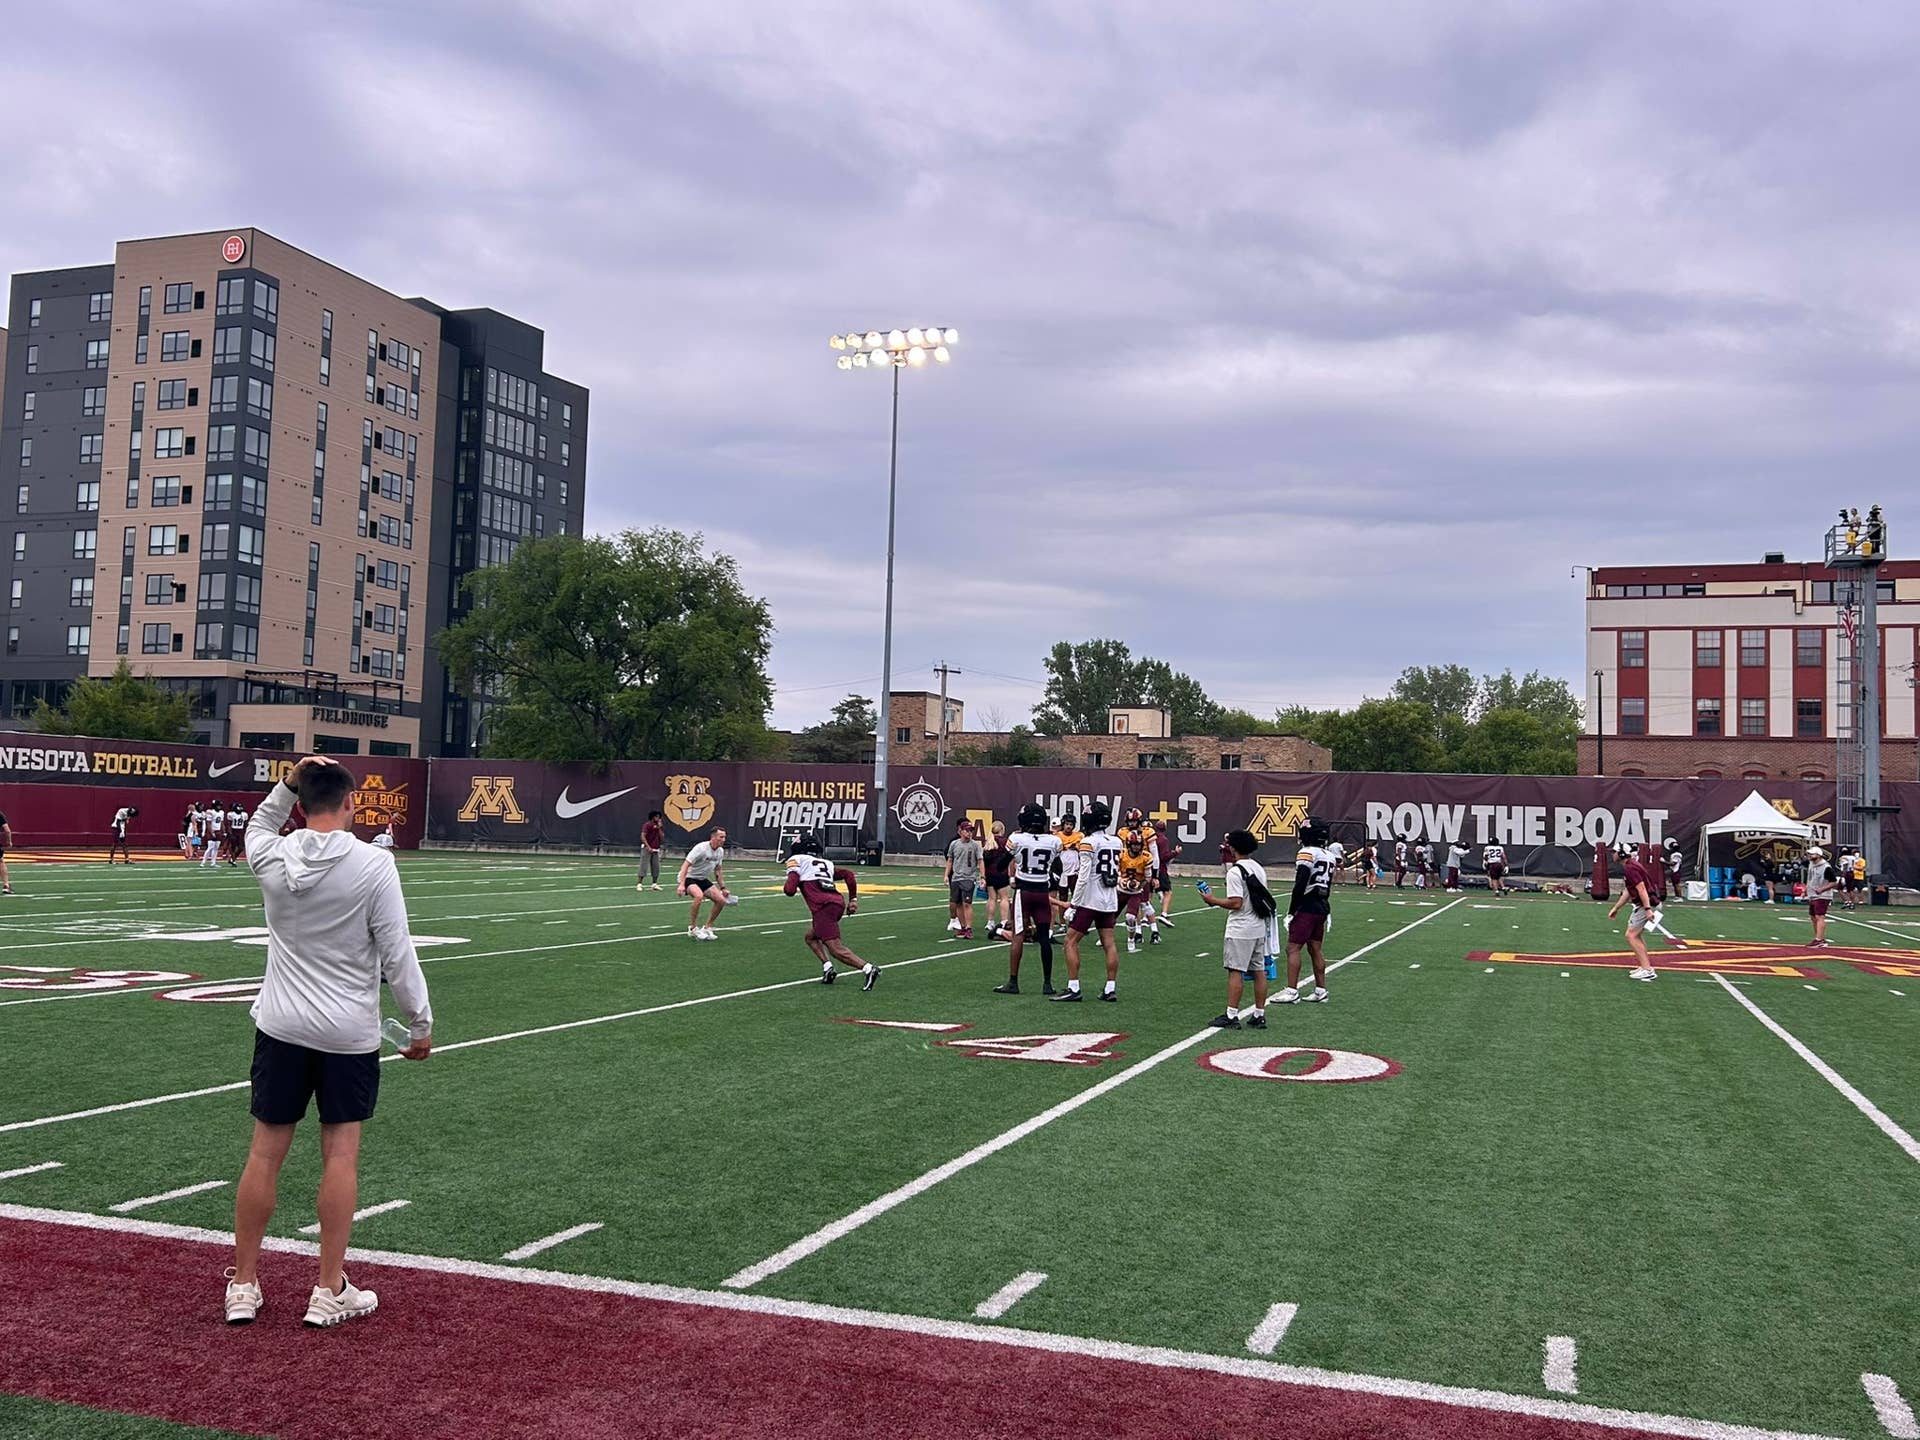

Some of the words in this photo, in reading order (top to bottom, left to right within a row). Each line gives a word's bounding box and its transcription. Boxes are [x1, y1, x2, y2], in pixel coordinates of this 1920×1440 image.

[312, 706, 389, 728] FIELDHOUSE
[0, 747, 90, 772] NESOTA
[93, 752, 197, 778] FOOTBALL
[380, 794, 406, 807] BOAT
[457, 776, 524, 823] M
[753, 781, 780, 798] THE
[783, 781, 818, 799] BALL
[820, 782, 835, 799] IS
[837, 782, 866, 800] THE
[748, 800, 867, 830] PROGRAM
[1366, 801, 1466, 842] ROW
[1471, 805, 1546, 845] THE
[1020, 848, 1051, 875] 13
[1489, 849, 1501, 858] 22
[812, 860, 831, 878] 3
